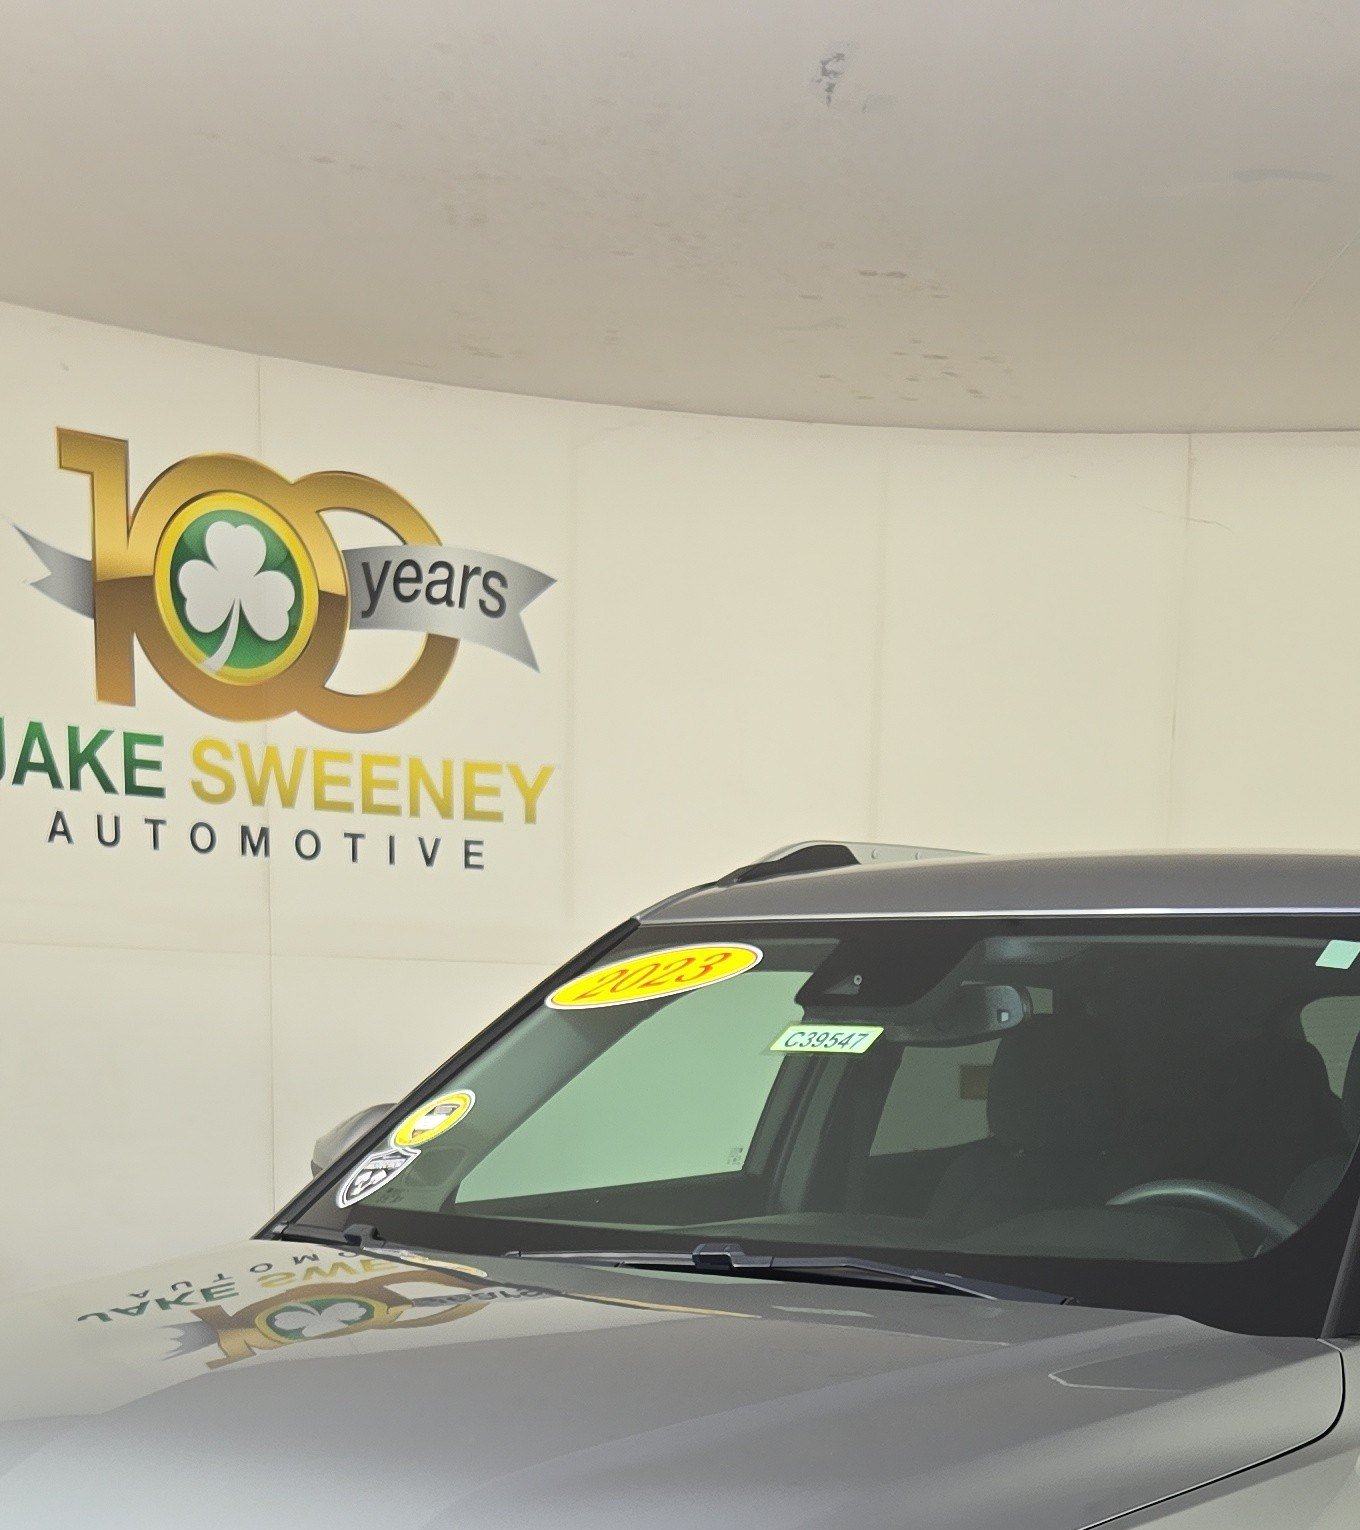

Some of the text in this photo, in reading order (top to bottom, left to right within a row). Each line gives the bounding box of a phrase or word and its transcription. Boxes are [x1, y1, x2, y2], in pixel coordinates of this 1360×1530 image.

[56, 426, 460, 733] 100
[361, 558, 509, 619] years
[191, 736, 554, 825] SWEENEY
[47, 810, 485, 870] AUTOMOTIVE
[574, 953, 732, 1000] 2023
[785, 1032, 869, 1050] C39547
